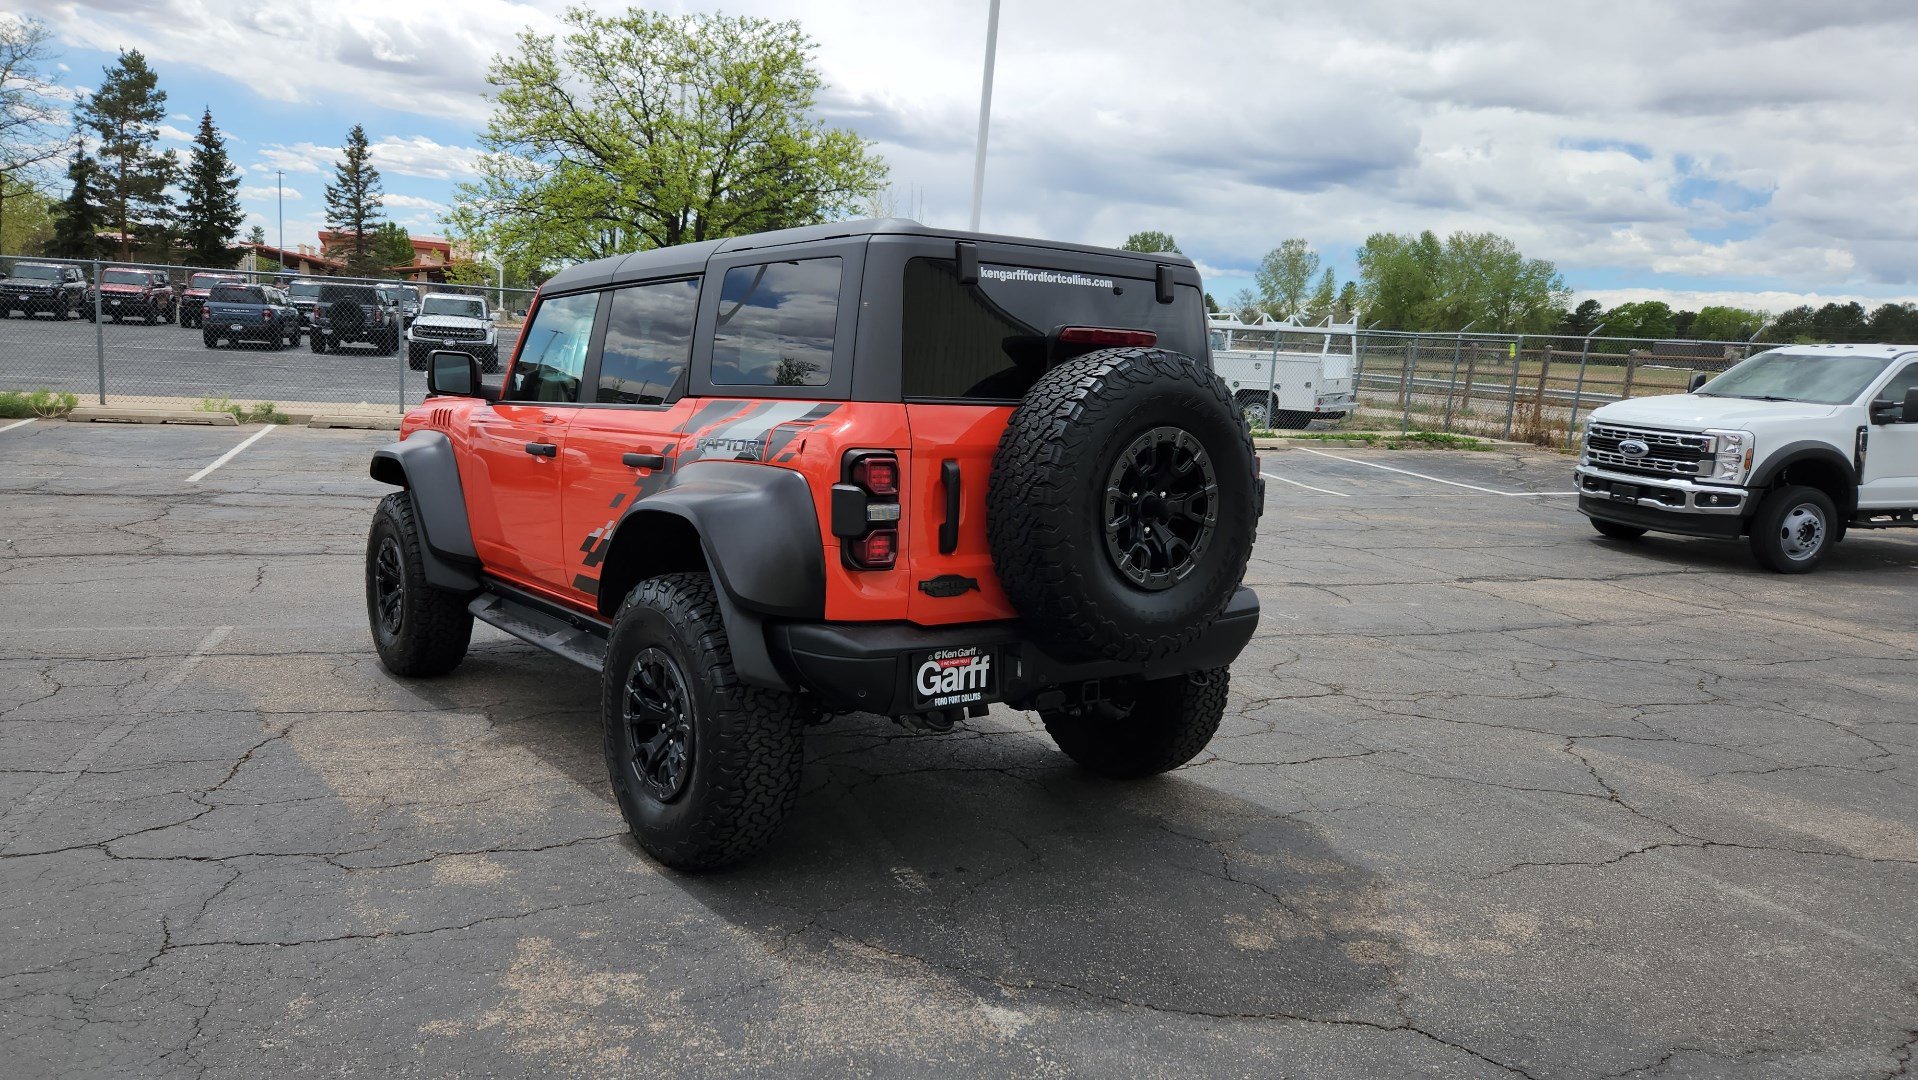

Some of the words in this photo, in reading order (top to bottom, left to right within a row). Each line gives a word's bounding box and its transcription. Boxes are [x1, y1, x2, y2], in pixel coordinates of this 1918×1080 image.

[980, 266, 1113, 288] kengarfffordfortcollins.com
[696, 437, 760, 461] RAPTOR
[942, 650, 957, 658] Ken
[957, 647, 976, 656] Garff
[917, 655, 990, 695] Garff
[934, 697, 948, 706] FORD
[948, 695, 961, 704] FORT
[961, 692, 981, 702] COLLINS
